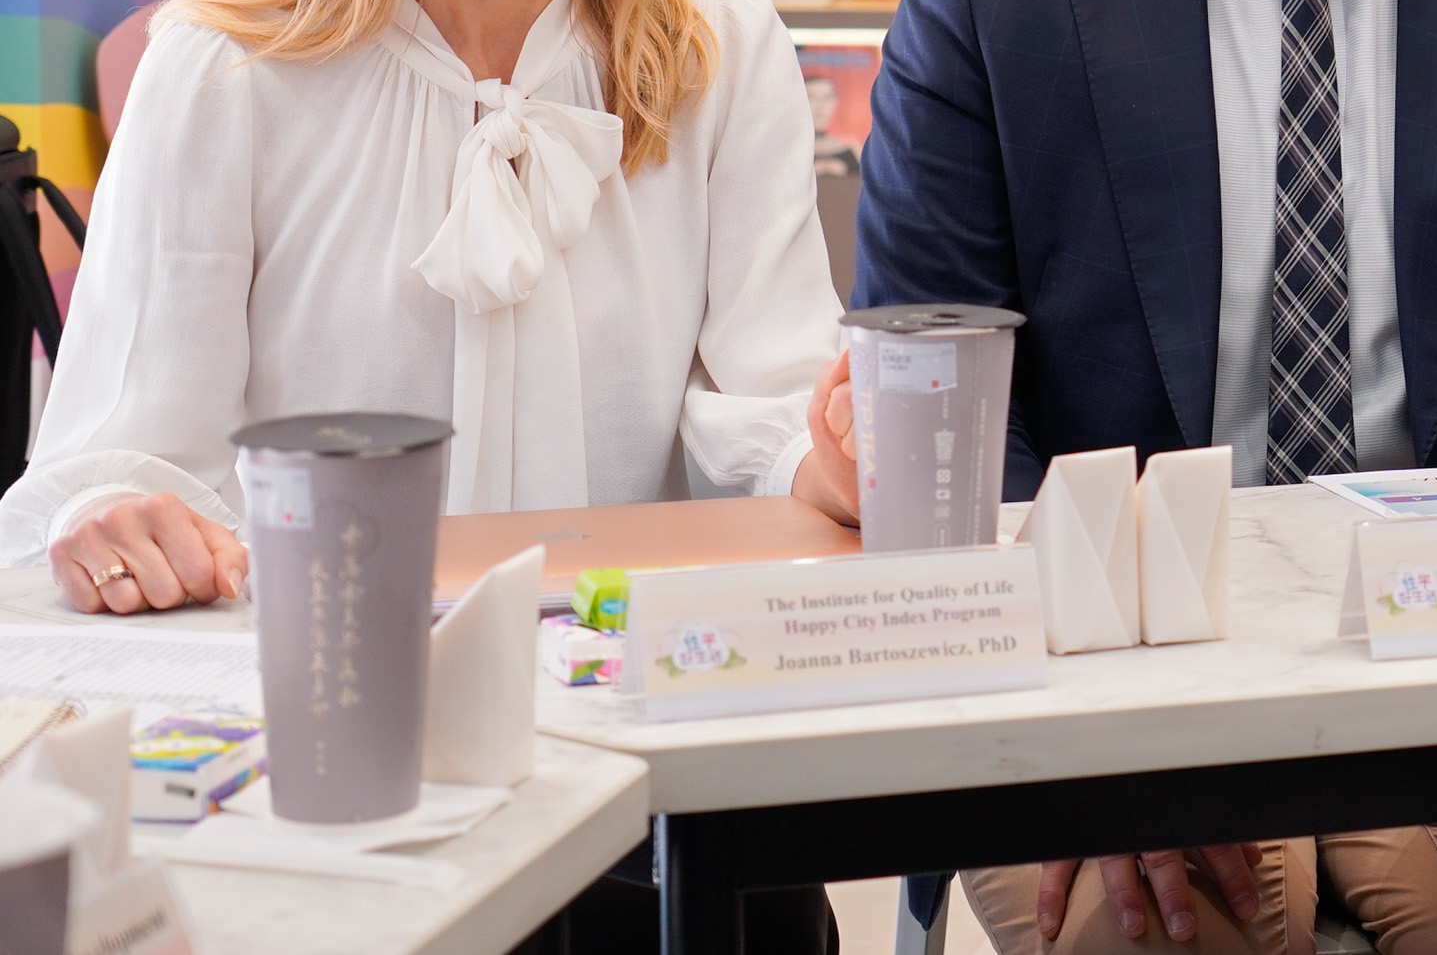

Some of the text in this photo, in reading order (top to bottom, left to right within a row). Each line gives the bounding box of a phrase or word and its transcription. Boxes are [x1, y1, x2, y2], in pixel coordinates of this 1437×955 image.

[765, 579, 1015, 613] The Institute for Quality of Life
[784, 604, 1001, 638] Happy City Index Program
[775, 635, 1018, 672] Joanna Bartoszewicz, PhD
